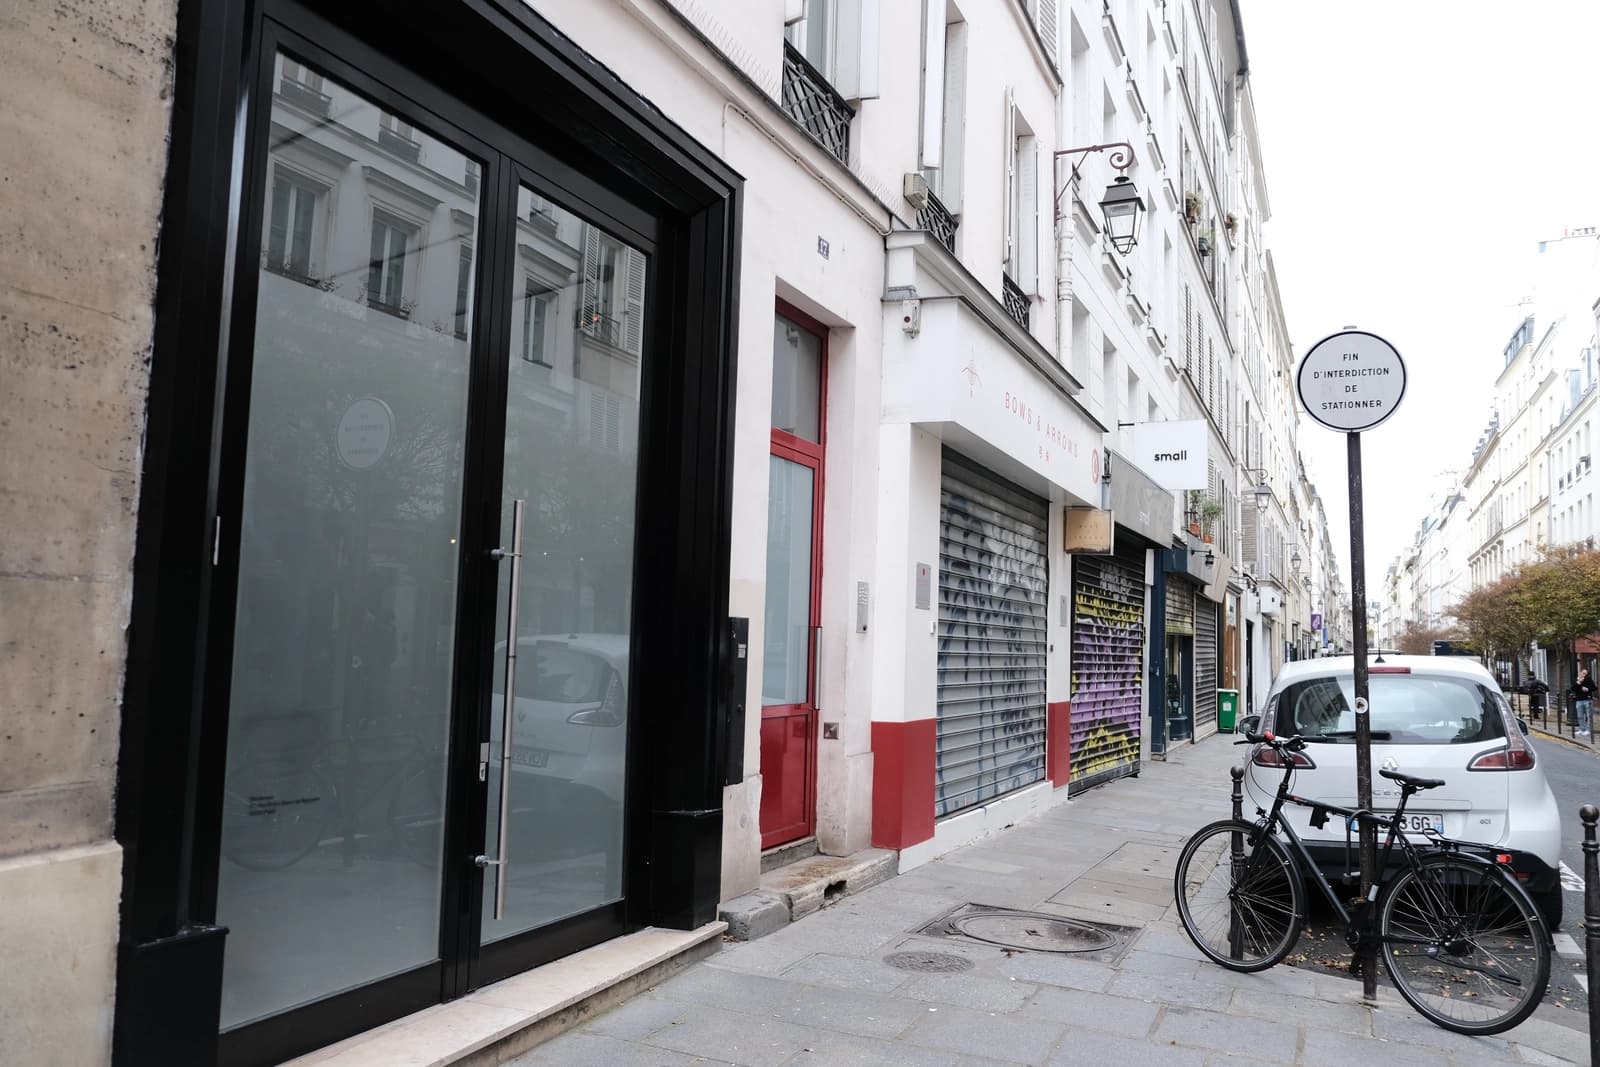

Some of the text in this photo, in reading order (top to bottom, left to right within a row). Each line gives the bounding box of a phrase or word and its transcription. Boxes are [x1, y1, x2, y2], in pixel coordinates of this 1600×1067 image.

[1343, 353, 1359, 361] FIN
[1313, 368, 1389, 379] D'INTERDICTION
[1345, 385, 1358, 393] DE
[1321, 400, 1382, 410] STATIONNER
[1005, 392, 1032, 425] BOWS
[1046, 423, 1078, 459] ARROWS
[1154, 450, 1187, 461] small
